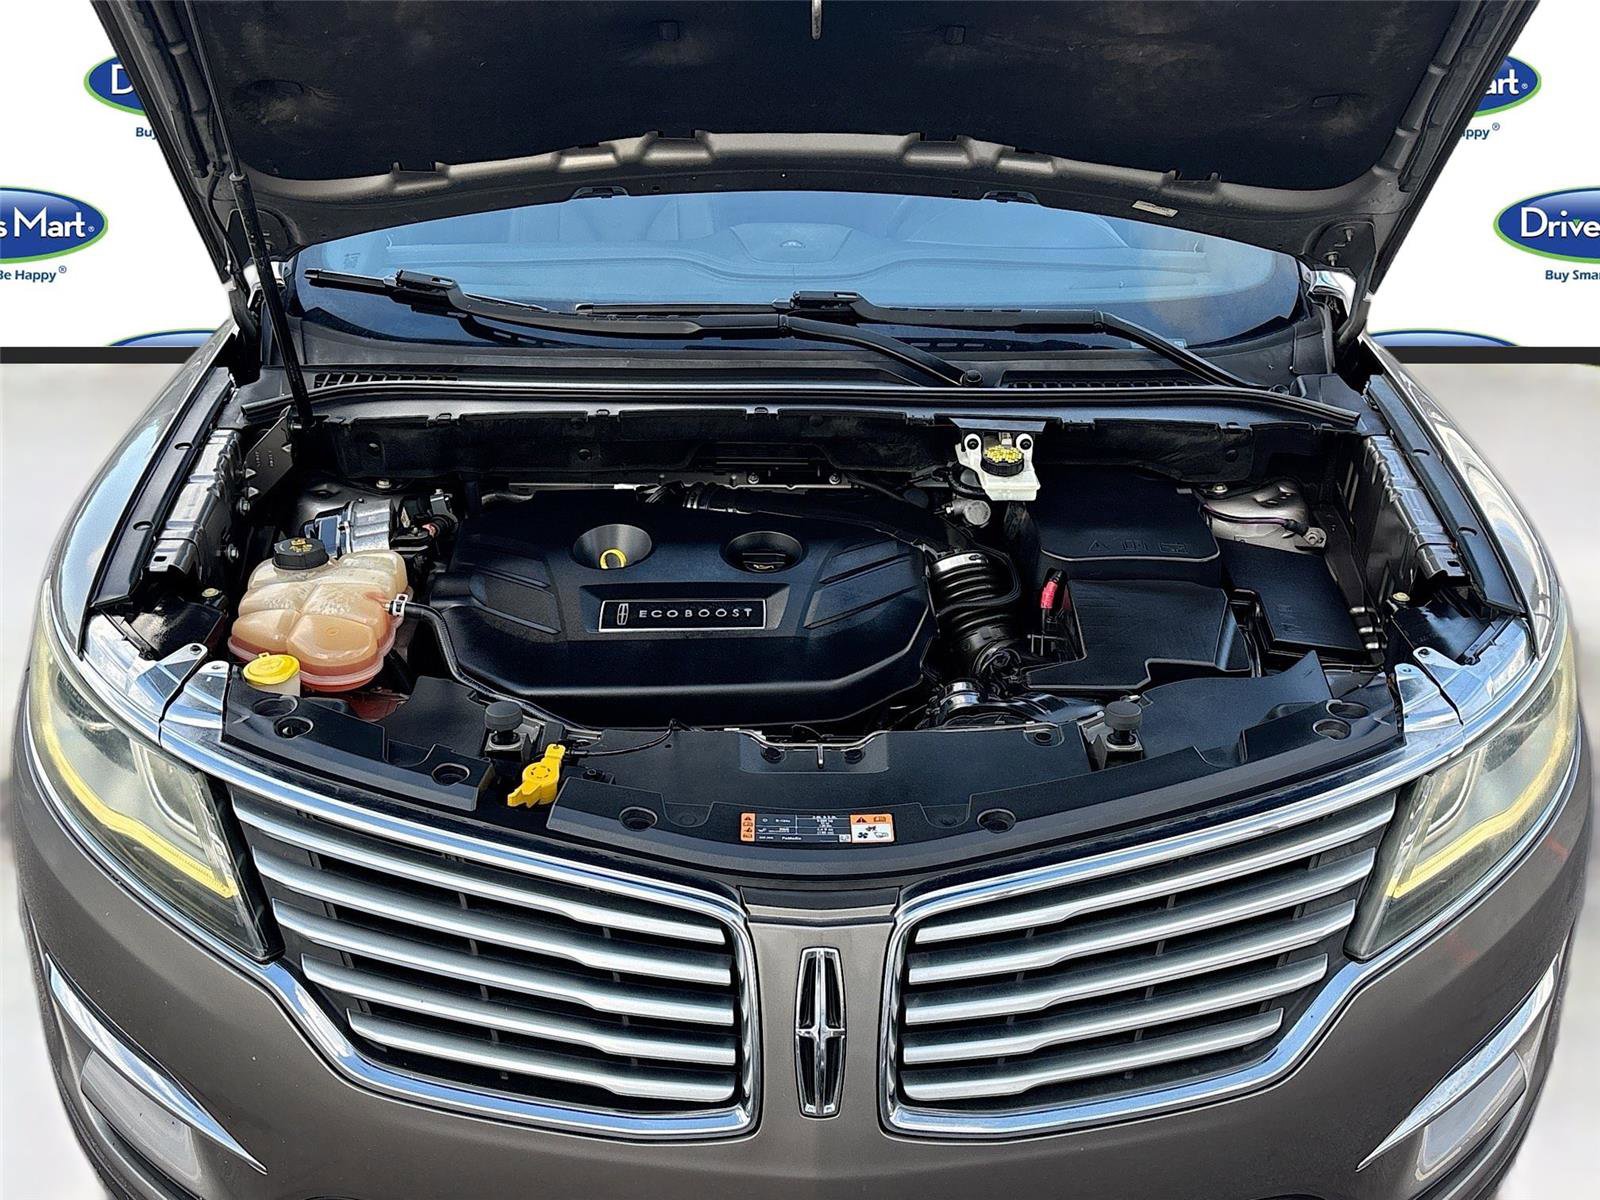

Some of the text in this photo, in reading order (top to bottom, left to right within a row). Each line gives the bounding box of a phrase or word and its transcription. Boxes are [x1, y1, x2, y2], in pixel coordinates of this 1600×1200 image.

[1485, 69, 1520, 95] art
[1462, 129, 1490, 140] ppy
[1521, 206, 1600, 238] Drive
[1545, 269, 1570, 283] Buy
[638, 607, 752, 618] ECOBOOST
